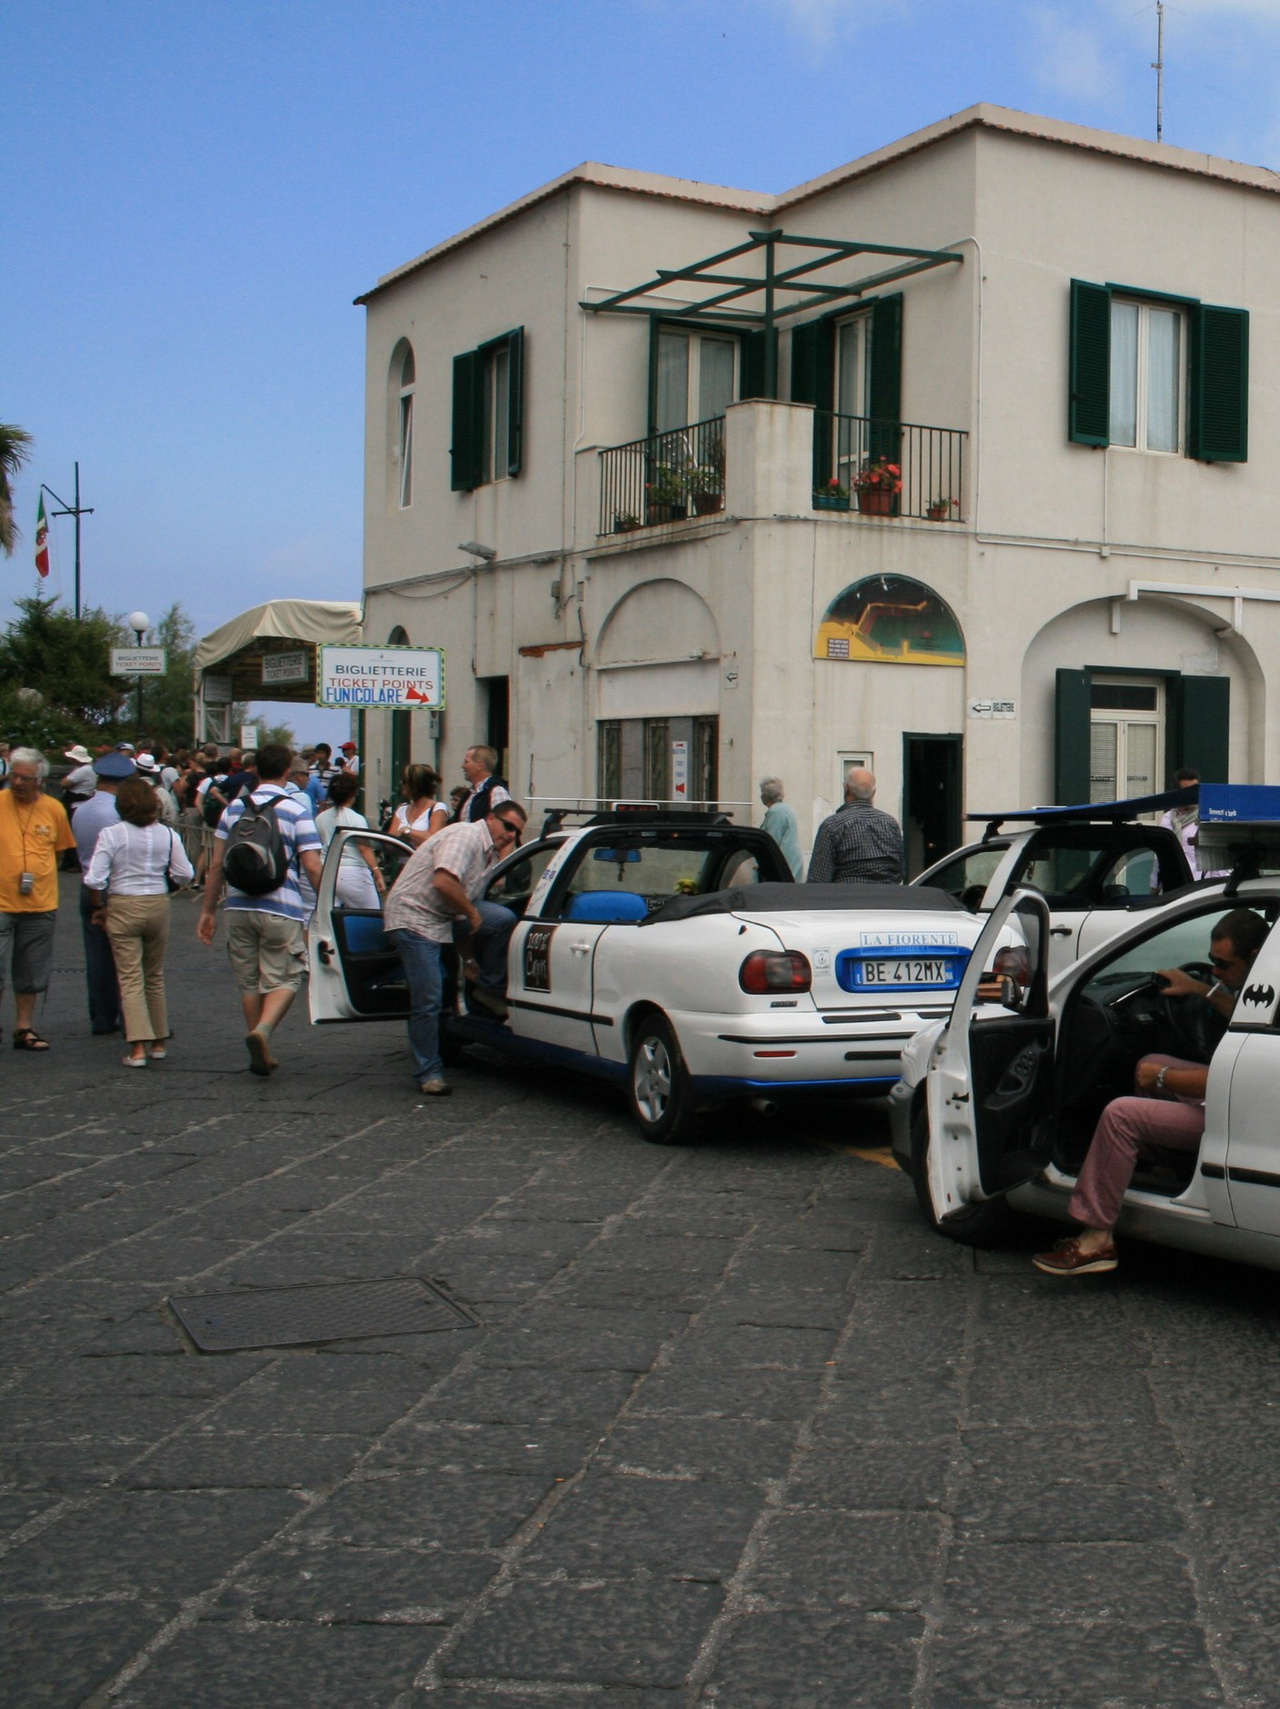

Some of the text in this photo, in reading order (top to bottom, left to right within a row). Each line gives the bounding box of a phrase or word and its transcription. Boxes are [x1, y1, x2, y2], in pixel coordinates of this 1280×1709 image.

[265, 654, 302, 669] BIGLIETTERIE
[335, 665, 427, 676] BIGLIETTERIE
[329, 678, 433, 689] TICKET POINTS
[326, 687, 403, 703] FUNICOLARE
[864, 934, 955, 945] LA FIORENTE
[866, 963, 886, 982] BE
[893, 962, 944, 981] 412MX
